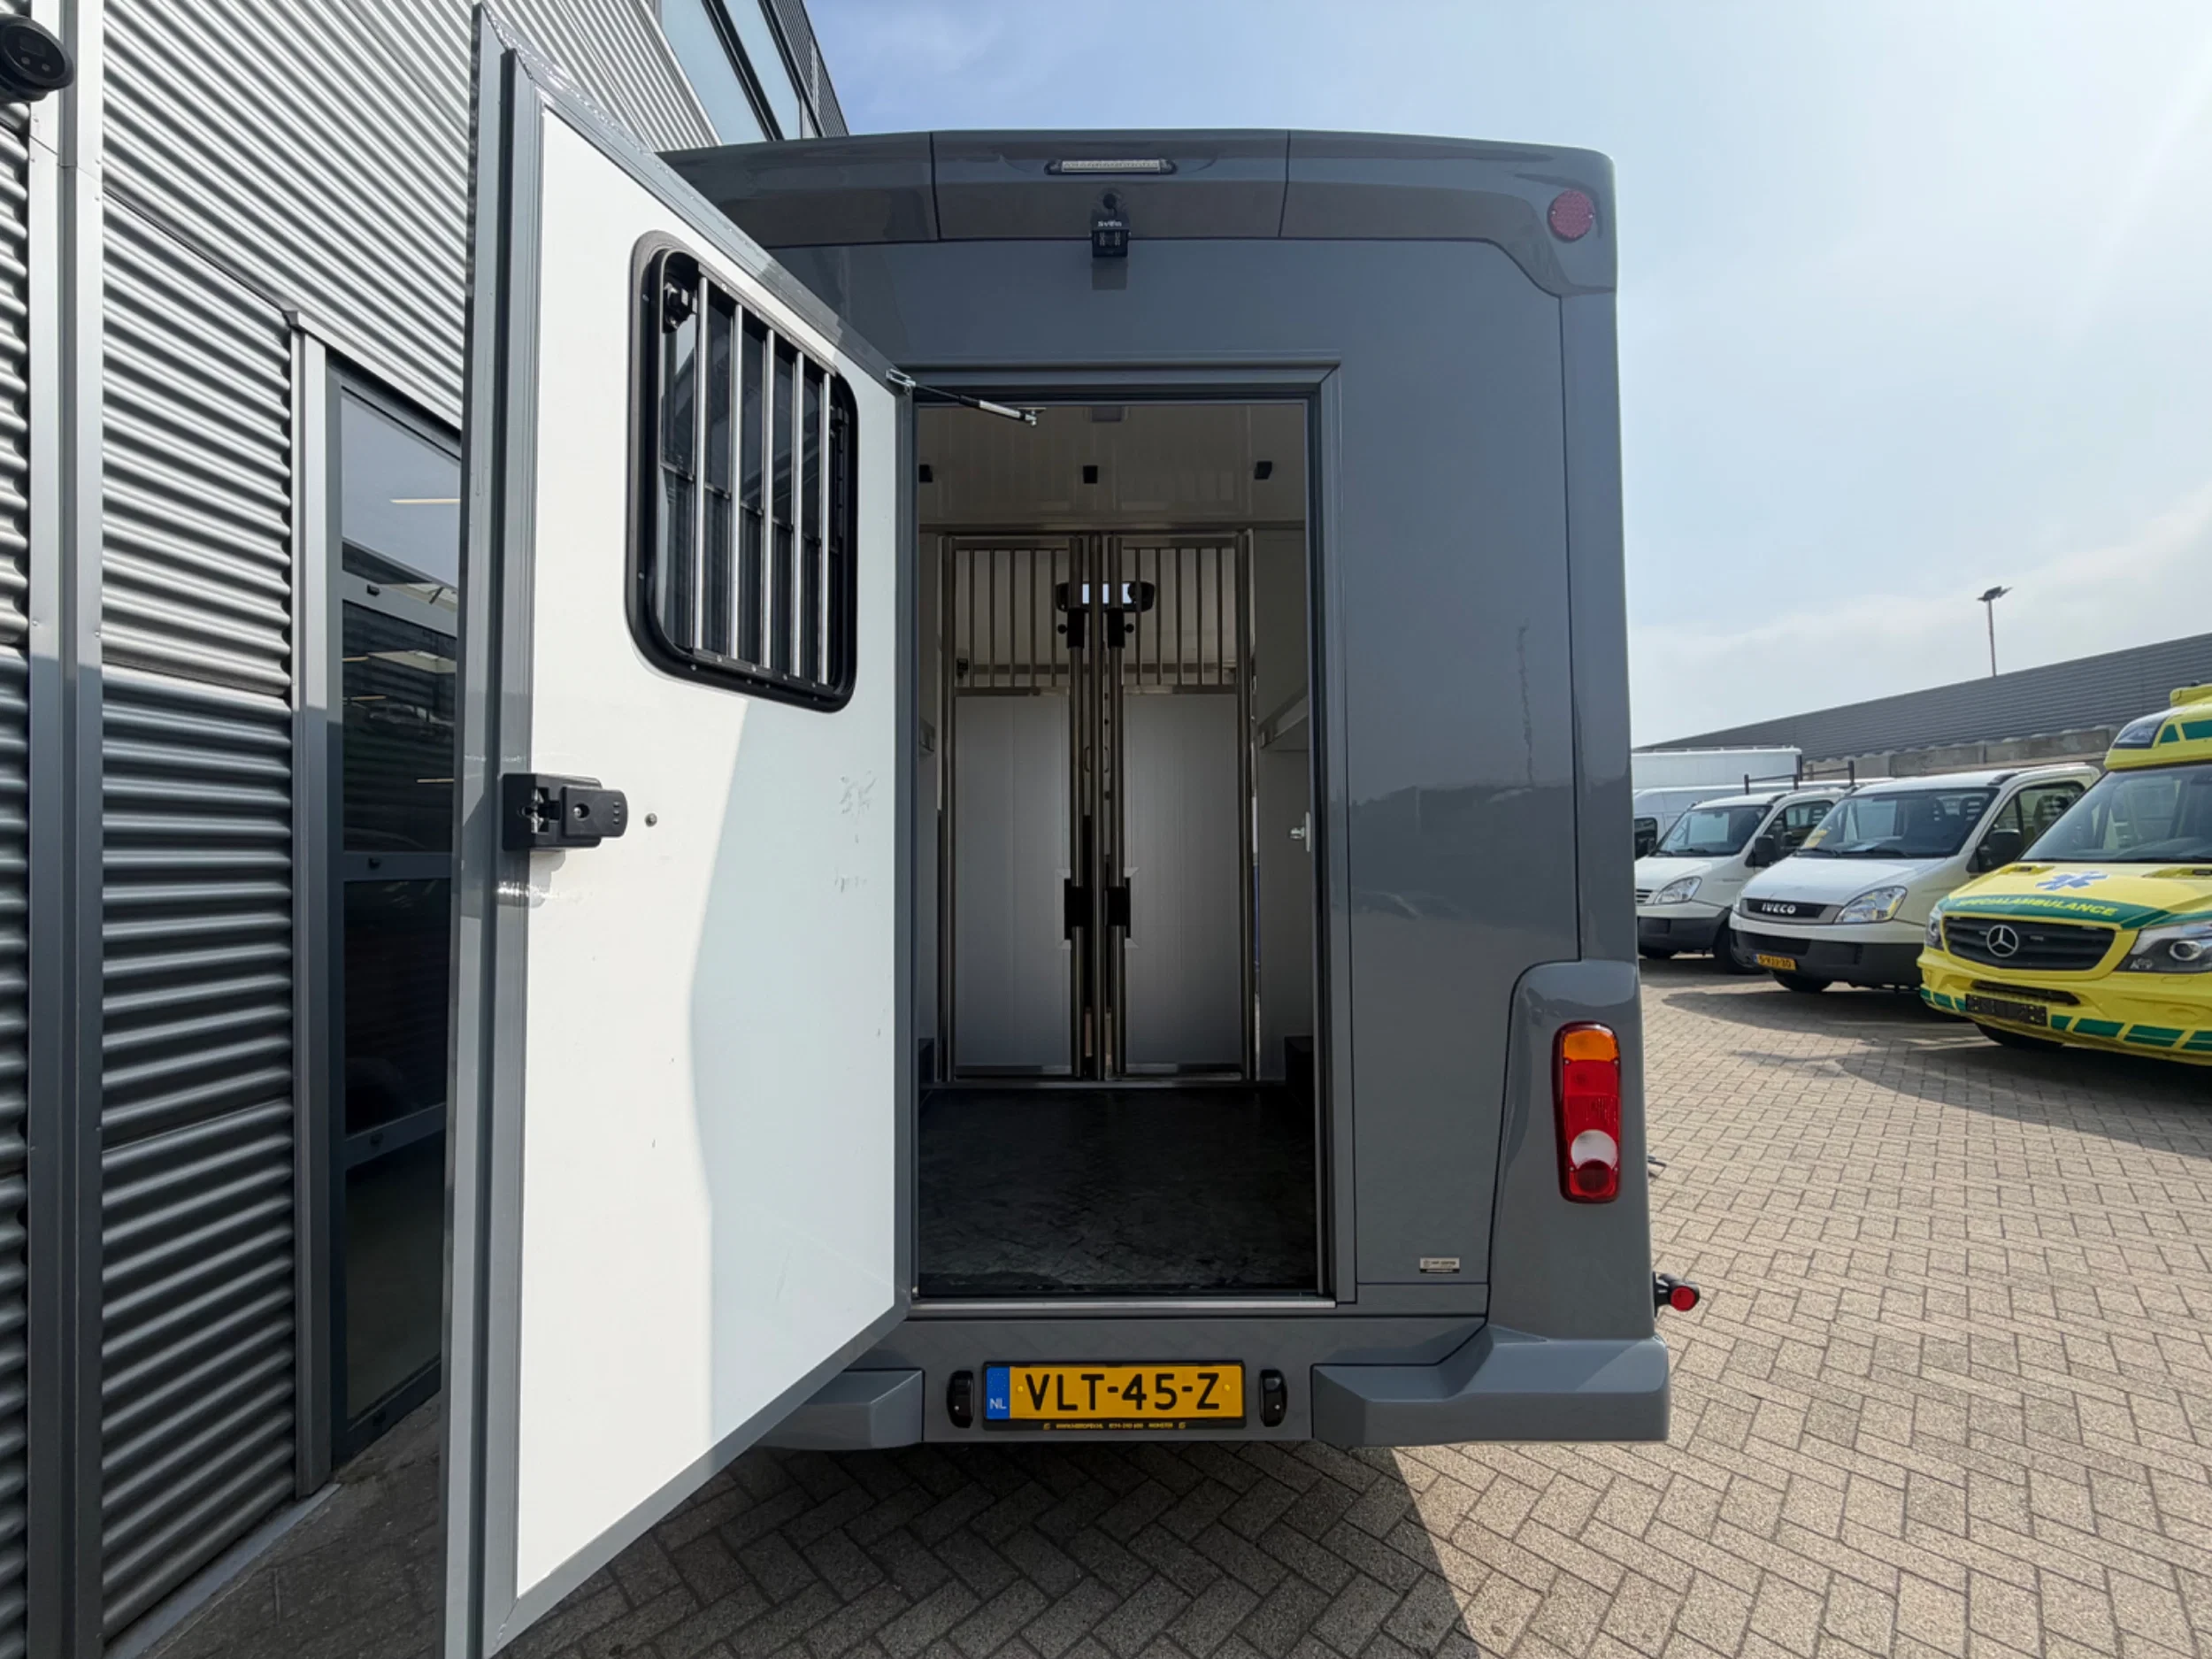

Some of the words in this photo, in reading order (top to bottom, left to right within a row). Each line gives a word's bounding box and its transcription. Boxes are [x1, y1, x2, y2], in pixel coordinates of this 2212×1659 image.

[1762, 902, 1796, 915] IVECO
[1025, 1373, 1220, 1411] VLT-45-Z
[989, 1398, 1007, 1409] NL
